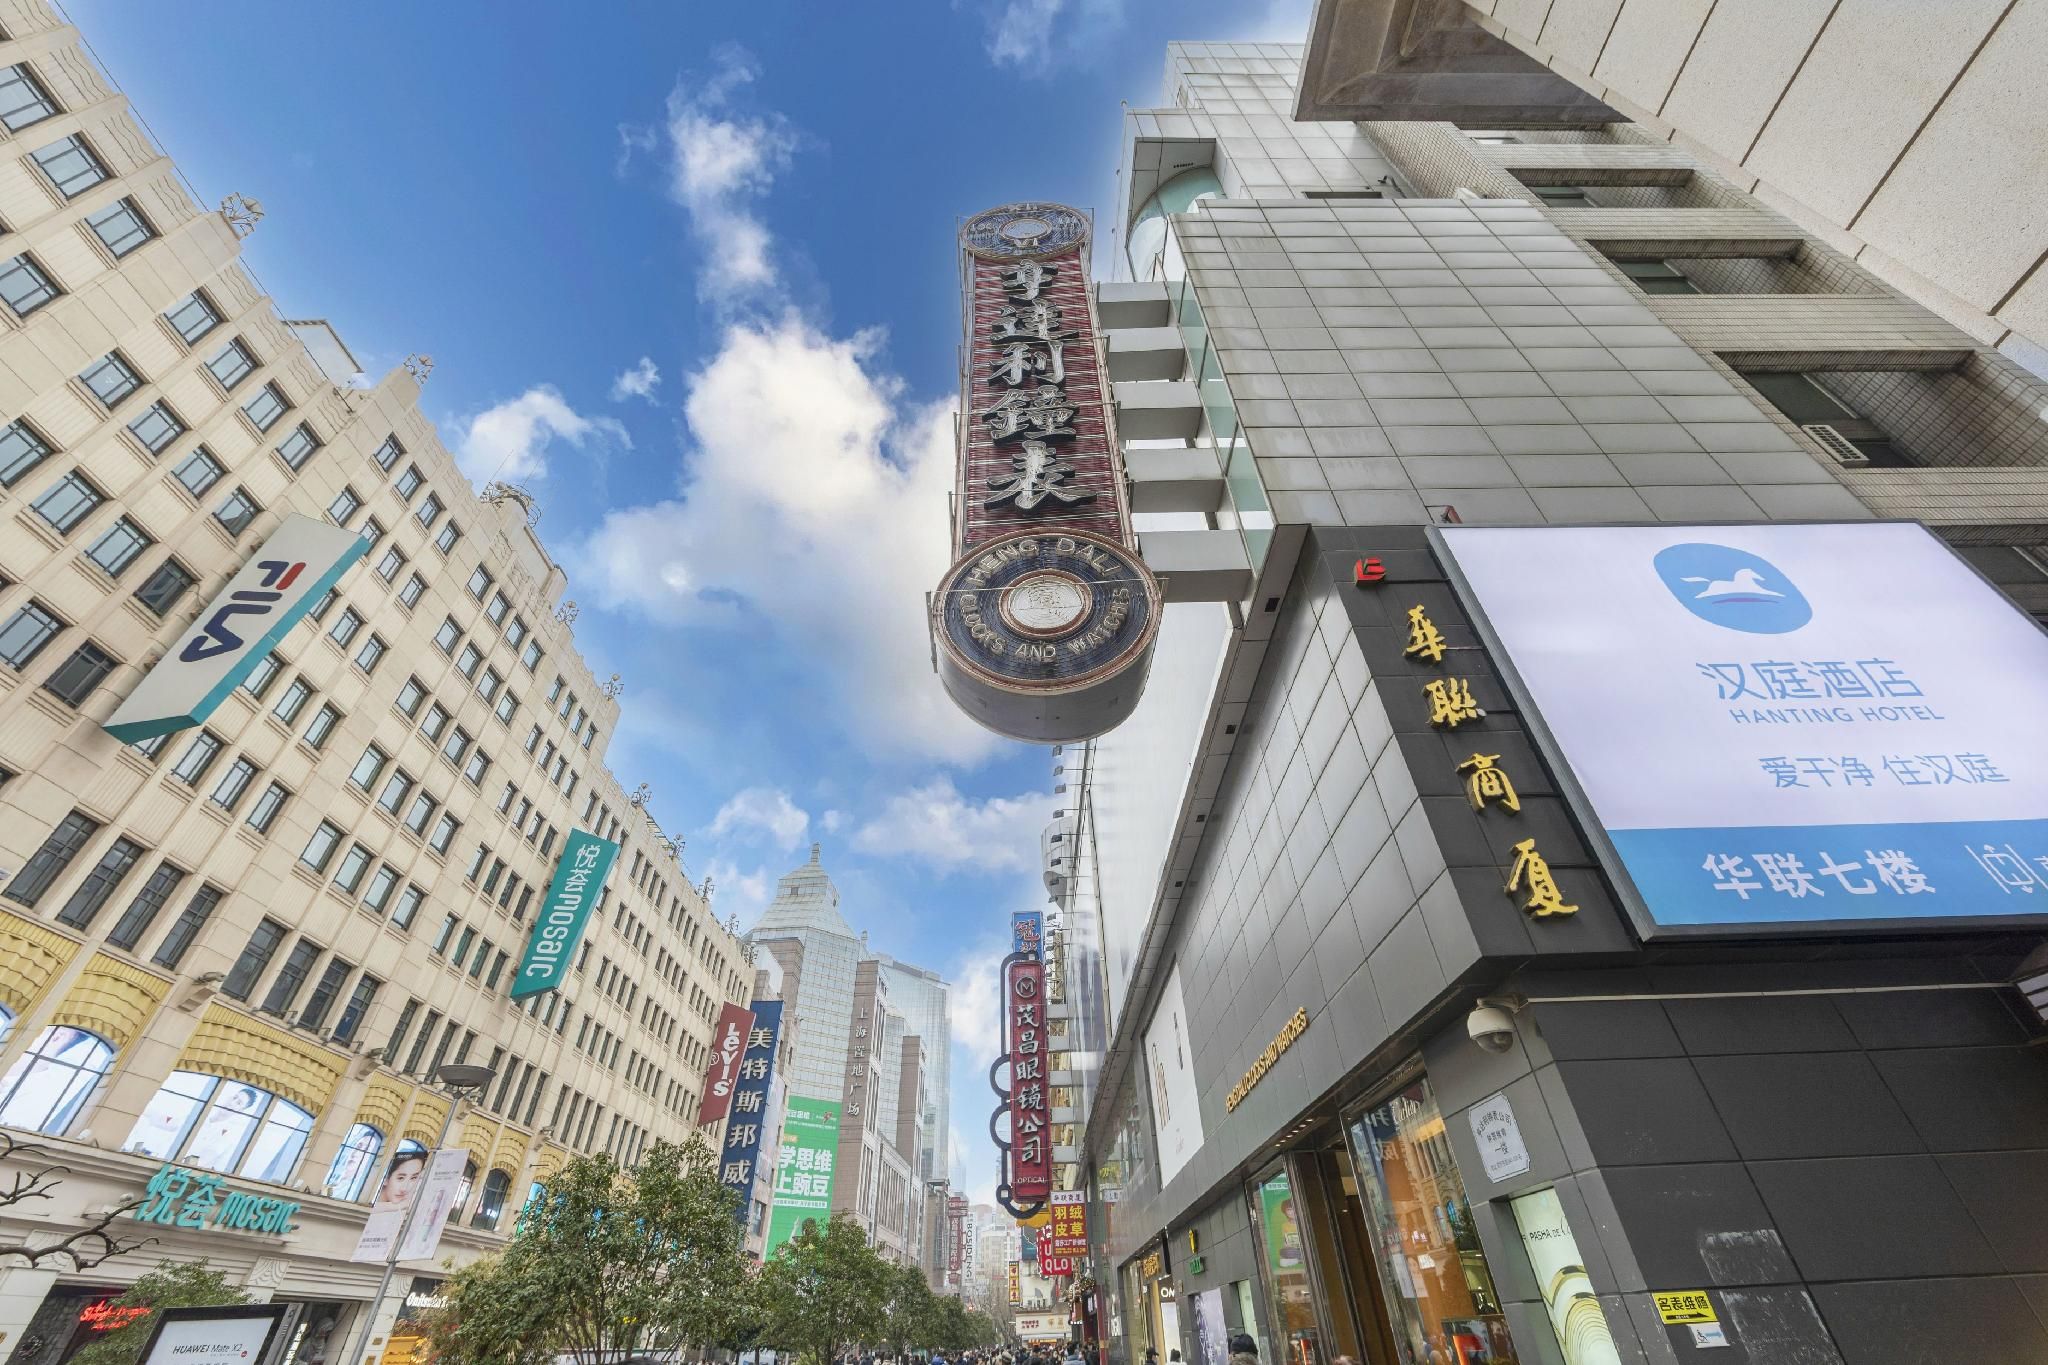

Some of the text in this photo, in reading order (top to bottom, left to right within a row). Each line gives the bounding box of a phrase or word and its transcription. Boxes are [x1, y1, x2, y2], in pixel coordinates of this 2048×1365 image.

[965, 537, 1122, 588] HENG DALI
[179, 560, 307, 662] FILA
[960, 588, 1130, 662] CLOCKS AND WATCHES
[1696, 657, 1925, 700] 汉庭酒店
[1729, 705, 1945, 724] HANTING HOTEL
[1758, 752, 2011, 788] 爱干净 住汉庭
[1702, 849, 1936, 900] 华联七楼
[847, 1007, 868, 1116] 上海置地广场
[1016, 1003, 1045, 1164] 茂昌眼镜公司
[721, 1027, 774, 1185] 美特斯邦威
[779, 1145, 833, 1172] 学思维
[776, 1170, 831, 1197] 上豌豆
[1054, 1205, 1083, 1220] 羽绒
[1055, 1221, 1085, 1237] 皮草
[965, 1223, 973, 1278] BOSIDENG
[1529, 1229, 1553, 1242] PASHA
[1045, 1258, 1069, 1273] QLO
[1658, 1295, 1709, 1311] 名表维修
[172, 1344, 211, 1355] HUAWEI
